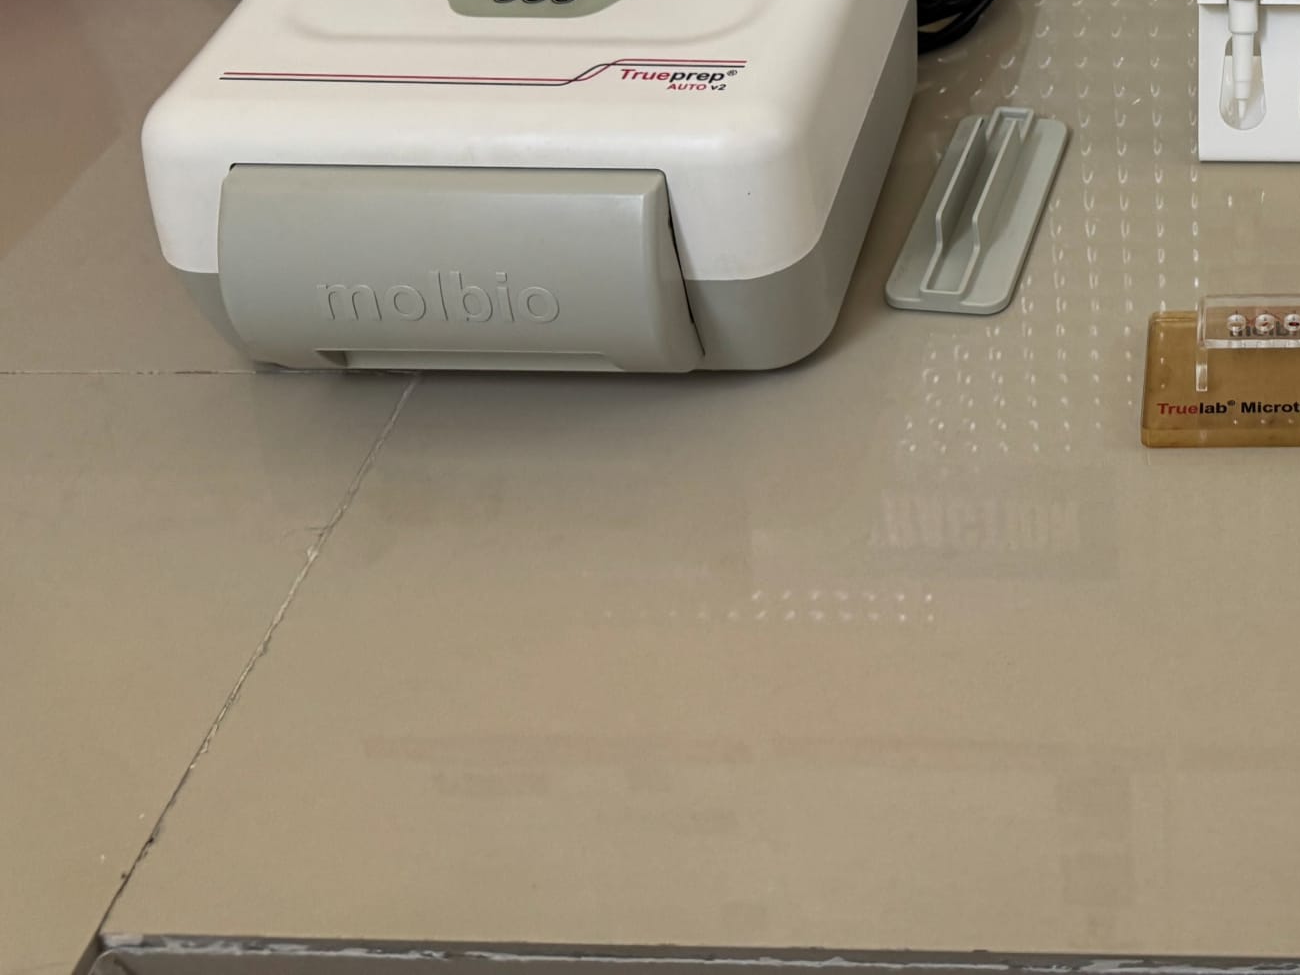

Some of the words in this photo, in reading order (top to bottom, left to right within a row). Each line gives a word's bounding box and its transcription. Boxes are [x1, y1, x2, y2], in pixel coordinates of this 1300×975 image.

[666, 83, 708, 91] AUTO
[710, 83, 727, 91] v2
[316, 270, 561, 323] molbio
